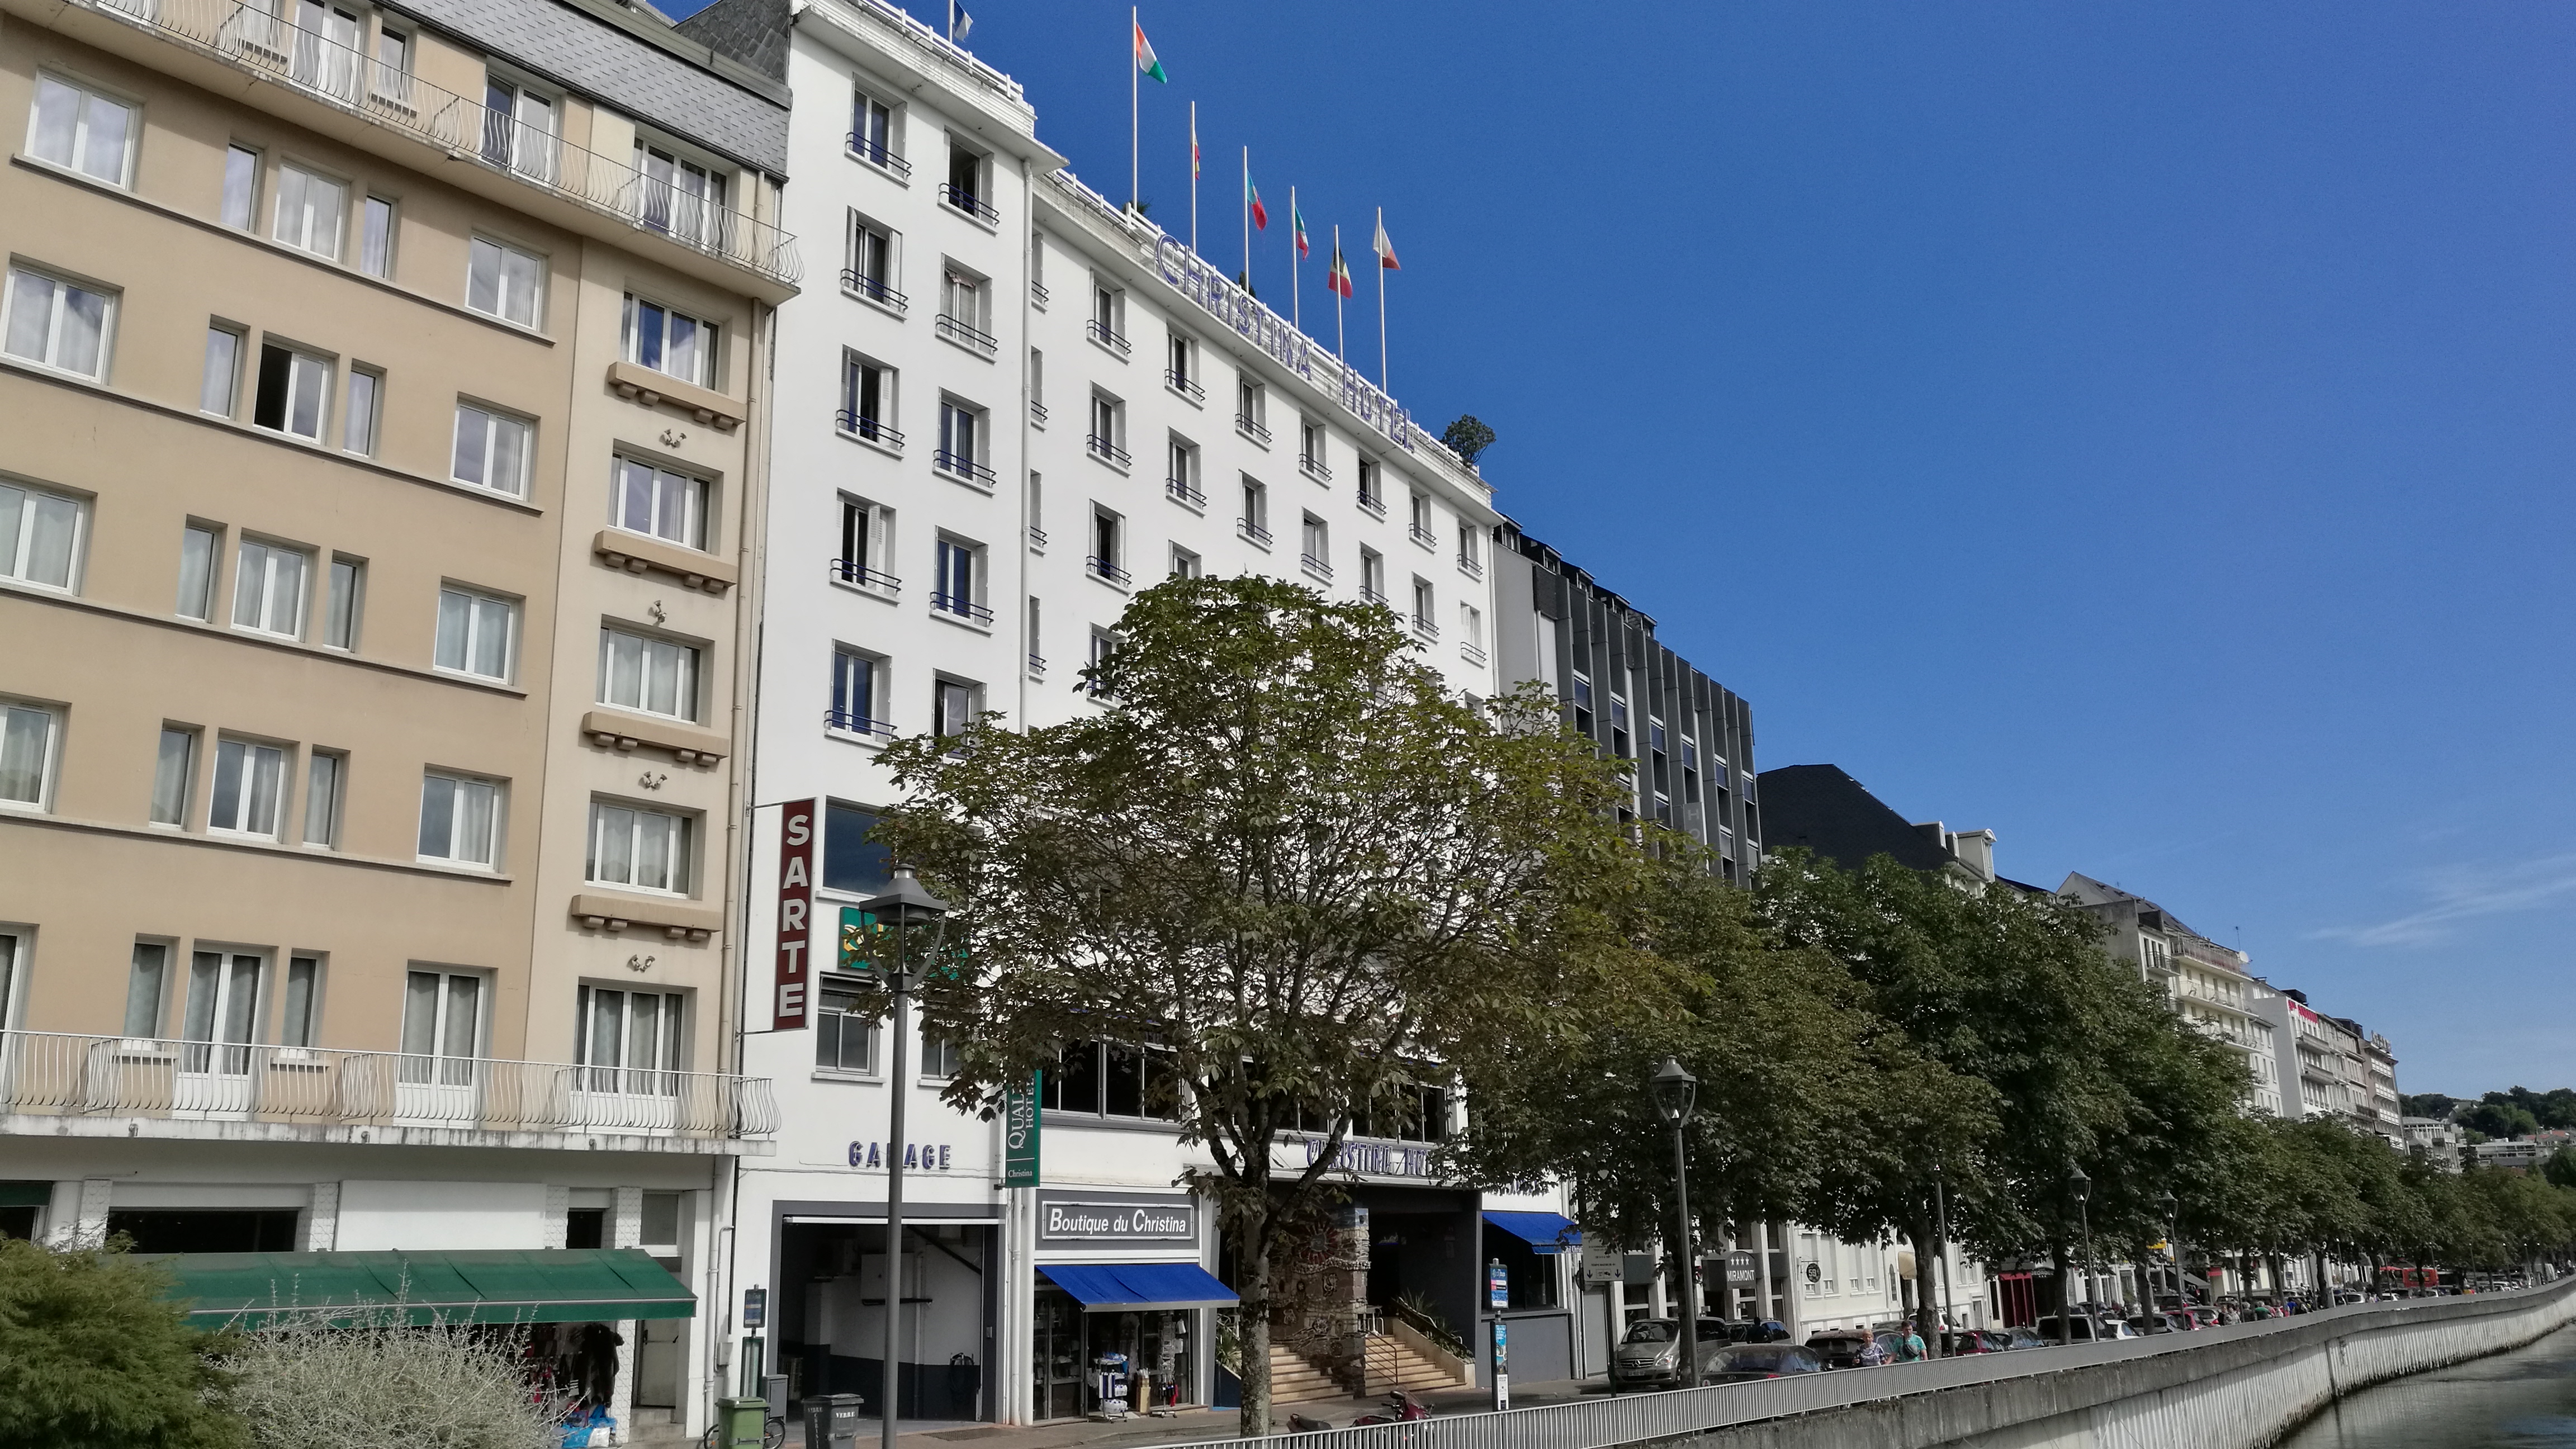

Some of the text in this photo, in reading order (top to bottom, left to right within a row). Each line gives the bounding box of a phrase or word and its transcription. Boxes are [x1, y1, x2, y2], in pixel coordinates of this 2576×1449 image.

[1156, 234, 1415, 454] CHRISTINA HOTEL
[778, 815, 810, 1018] SARTE
[849, 1140, 951, 1170] GAAGE
[1008, 1169, 1033, 1178] Christina
[1049, 1208, 1186, 1235] Boutique du Christina
[1727, 1270, 1755, 1281] MIRAMONT
